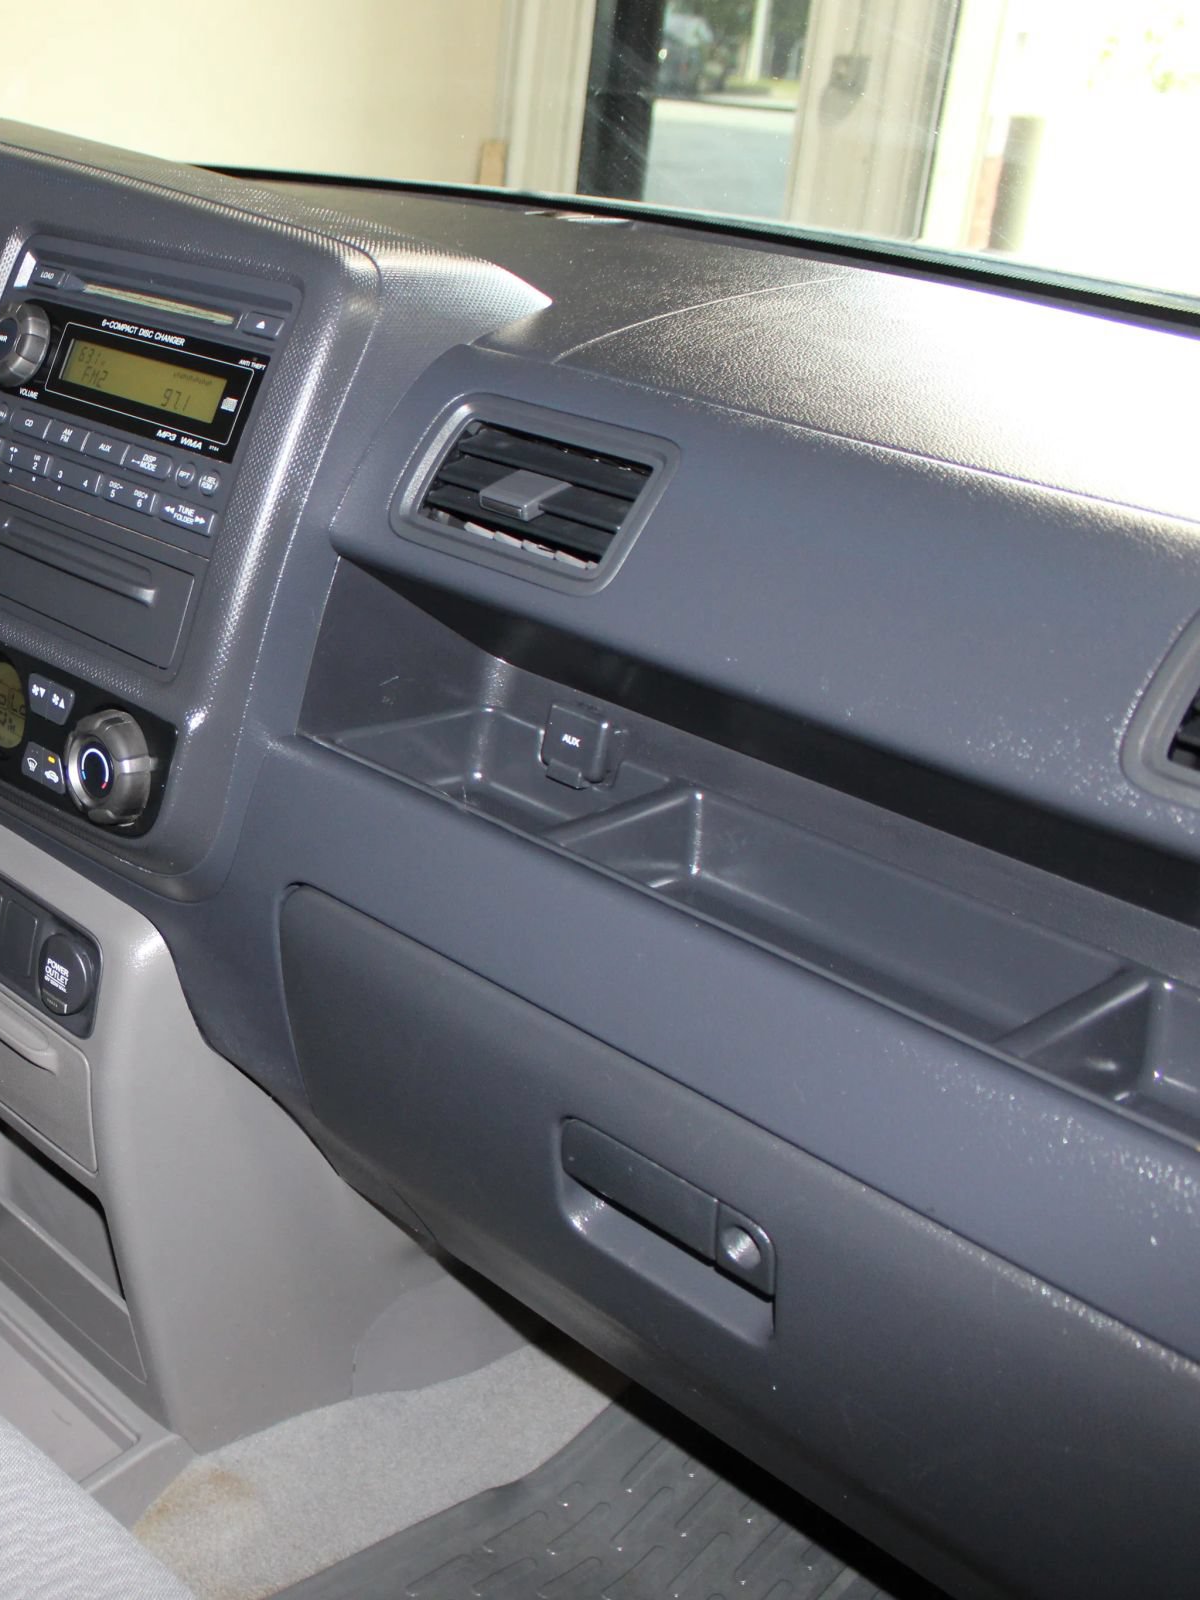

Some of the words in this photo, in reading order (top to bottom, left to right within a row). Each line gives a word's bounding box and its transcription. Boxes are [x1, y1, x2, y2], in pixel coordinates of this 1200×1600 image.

[40, 271, 54, 280] LOAD
[102, 319, 137, 336] 6-COMPACT
[139, 328, 154, 339] DISC
[154, 332, 186, 347] CHANGER
[238, 359, 251, 367] ANTI
[251, 361, 267, 371] THEFT
[20, 387, 39, 400] VOLUME
[25, 419, 34, 427] CD
[62, 428, 74, 437] AM
[59, 434, 70, 443] FM
[156, 429, 177, 442] MP3
[180, 436, 203, 450] WMA
[99, 442, 112, 453] AUX
[143, 453, 157, 463] DISP
[32, 461, 38, 471] 2
[140, 461, 158, 472] MODE
[57, 470, 63, 479] 3
[179, 470, 191, 479] RPT
[82, 479, 89, 488] 4
[110, 489, 116, 498] 5
[136, 499, 143, 508] 6
[178, 504, 196, 517] TUNE
[173, 513, 195, 525] FOLDER
[561, 733, 581, 748] AUX
[47, 957, 70, 978] POWER
[44, 965, 69, 986] OUTLET
